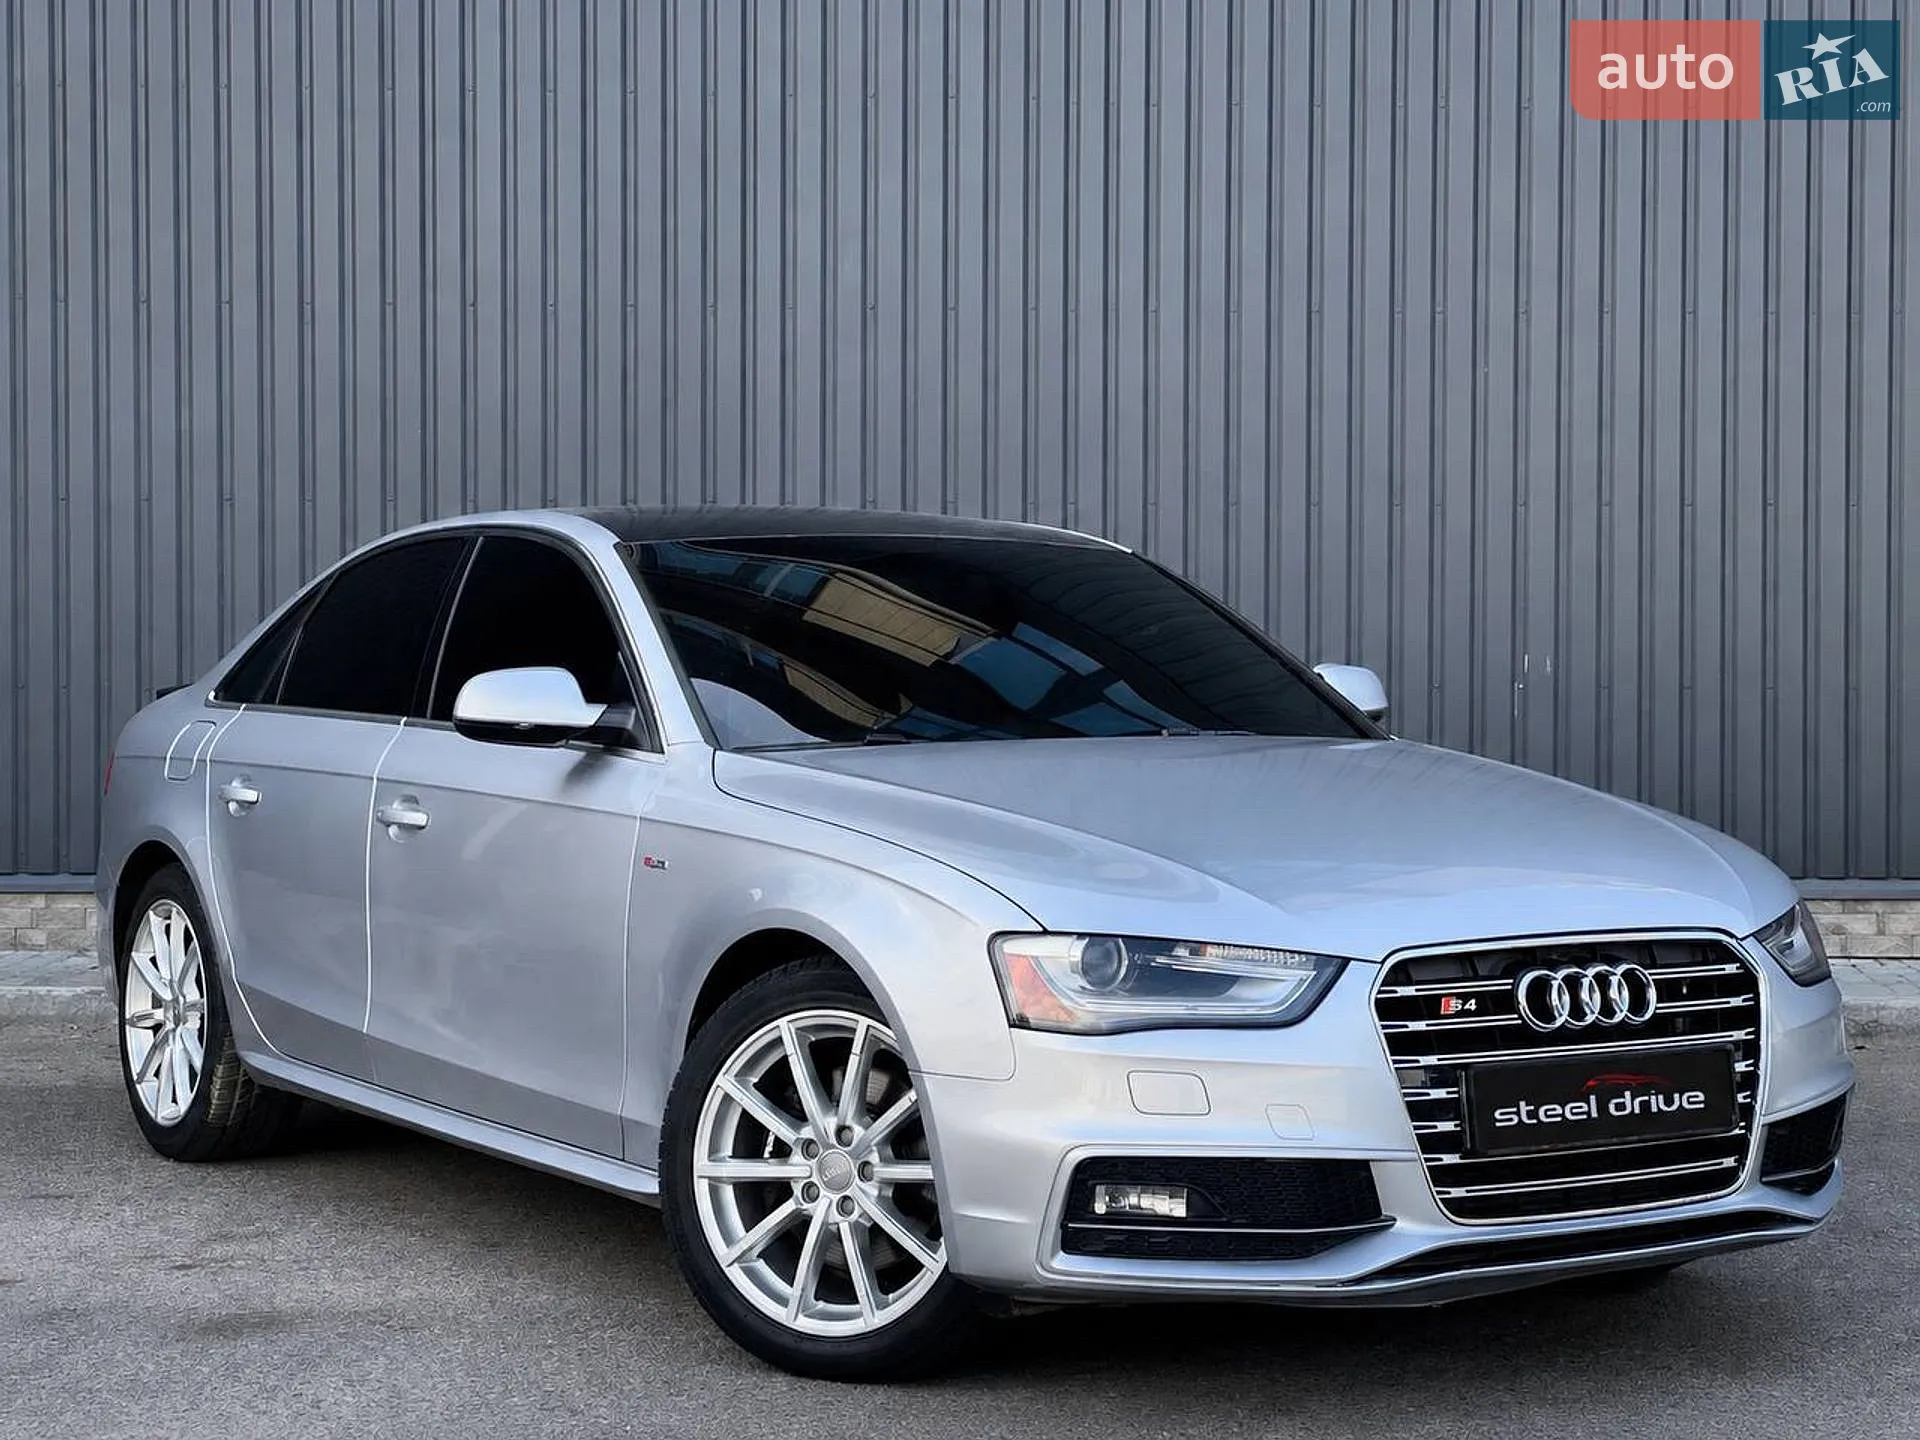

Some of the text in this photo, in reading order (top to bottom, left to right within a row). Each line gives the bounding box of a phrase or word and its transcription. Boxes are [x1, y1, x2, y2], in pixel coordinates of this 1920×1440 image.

[1449, 998, 1477, 1012] S4
[1494, 1090, 1705, 1127] steel drive
